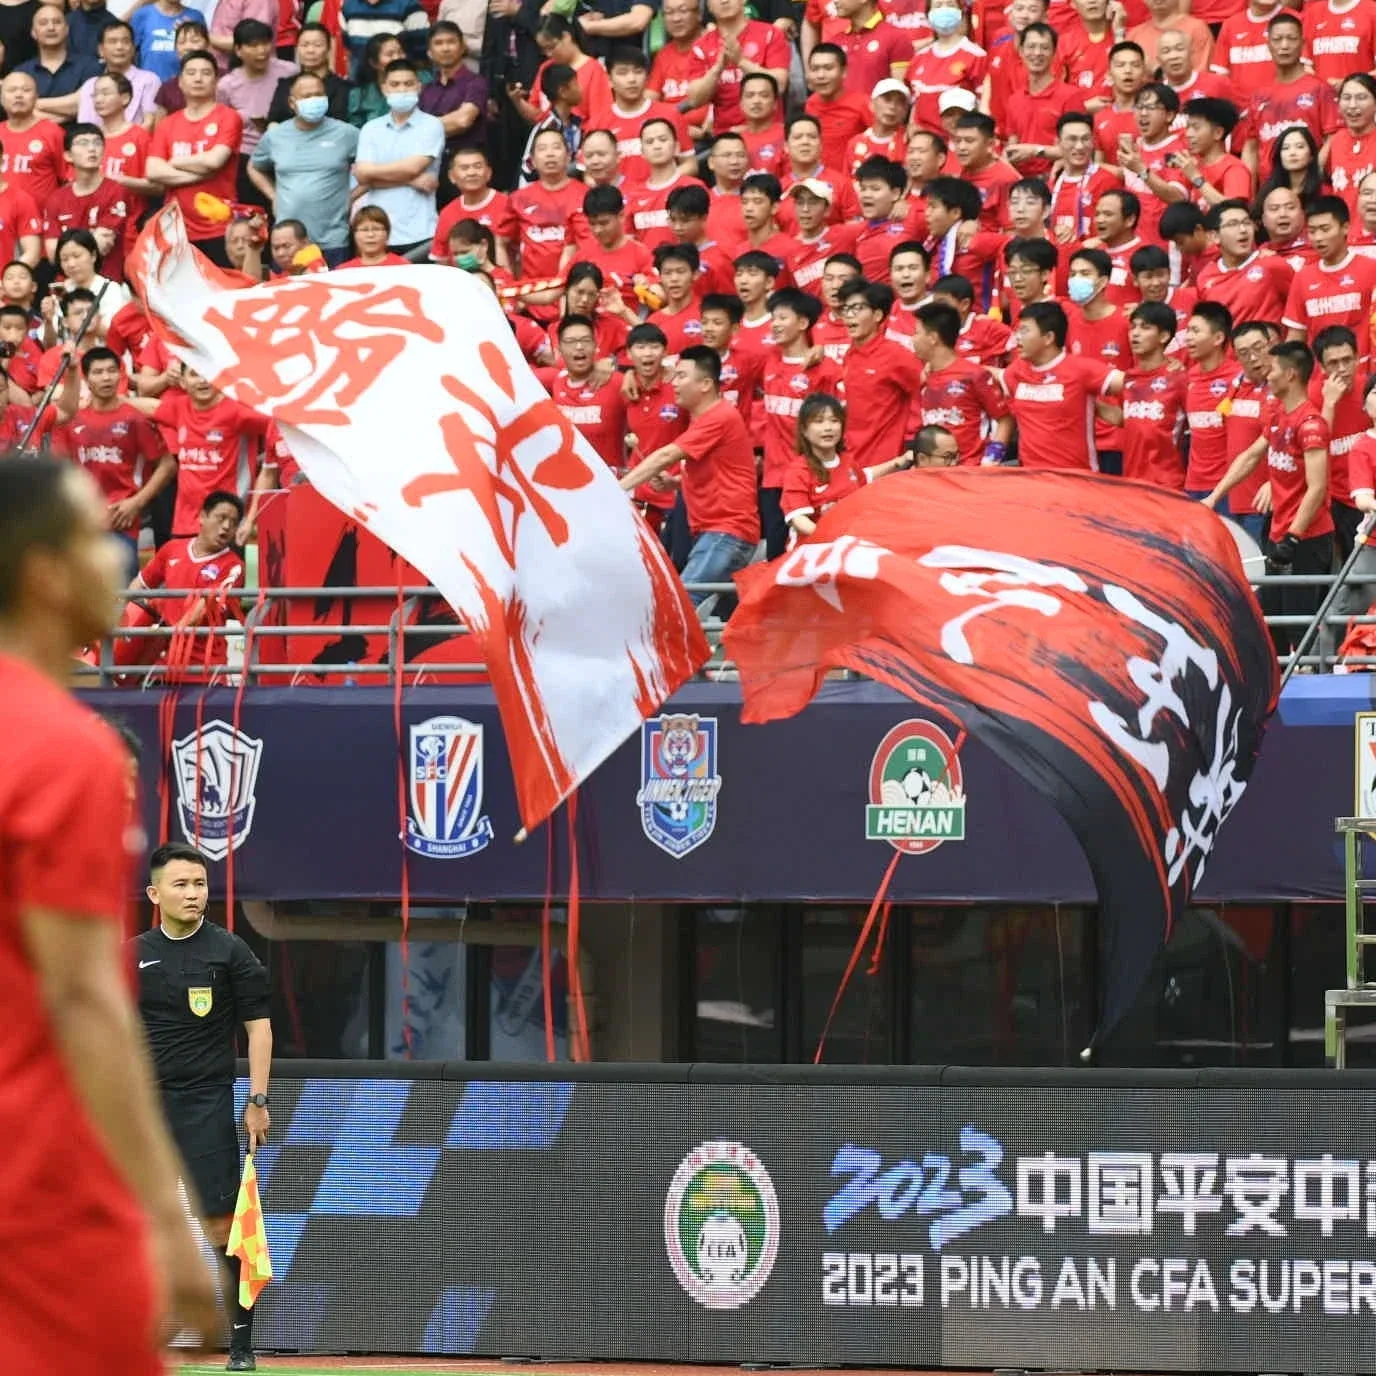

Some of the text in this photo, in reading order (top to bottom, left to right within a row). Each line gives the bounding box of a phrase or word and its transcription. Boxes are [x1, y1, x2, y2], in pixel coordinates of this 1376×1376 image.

[416, 765, 448, 779] SFC
[876, 808, 955, 836] HENAN
[427, 841, 467, 855] SHANGHAI
[822, 1251, 925, 1308] 2023
[940, 1255, 1044, 1310] PING
[1050, 1257, 1117, 1310] AN
[1130, 1257, 1218, 1312] CFA
